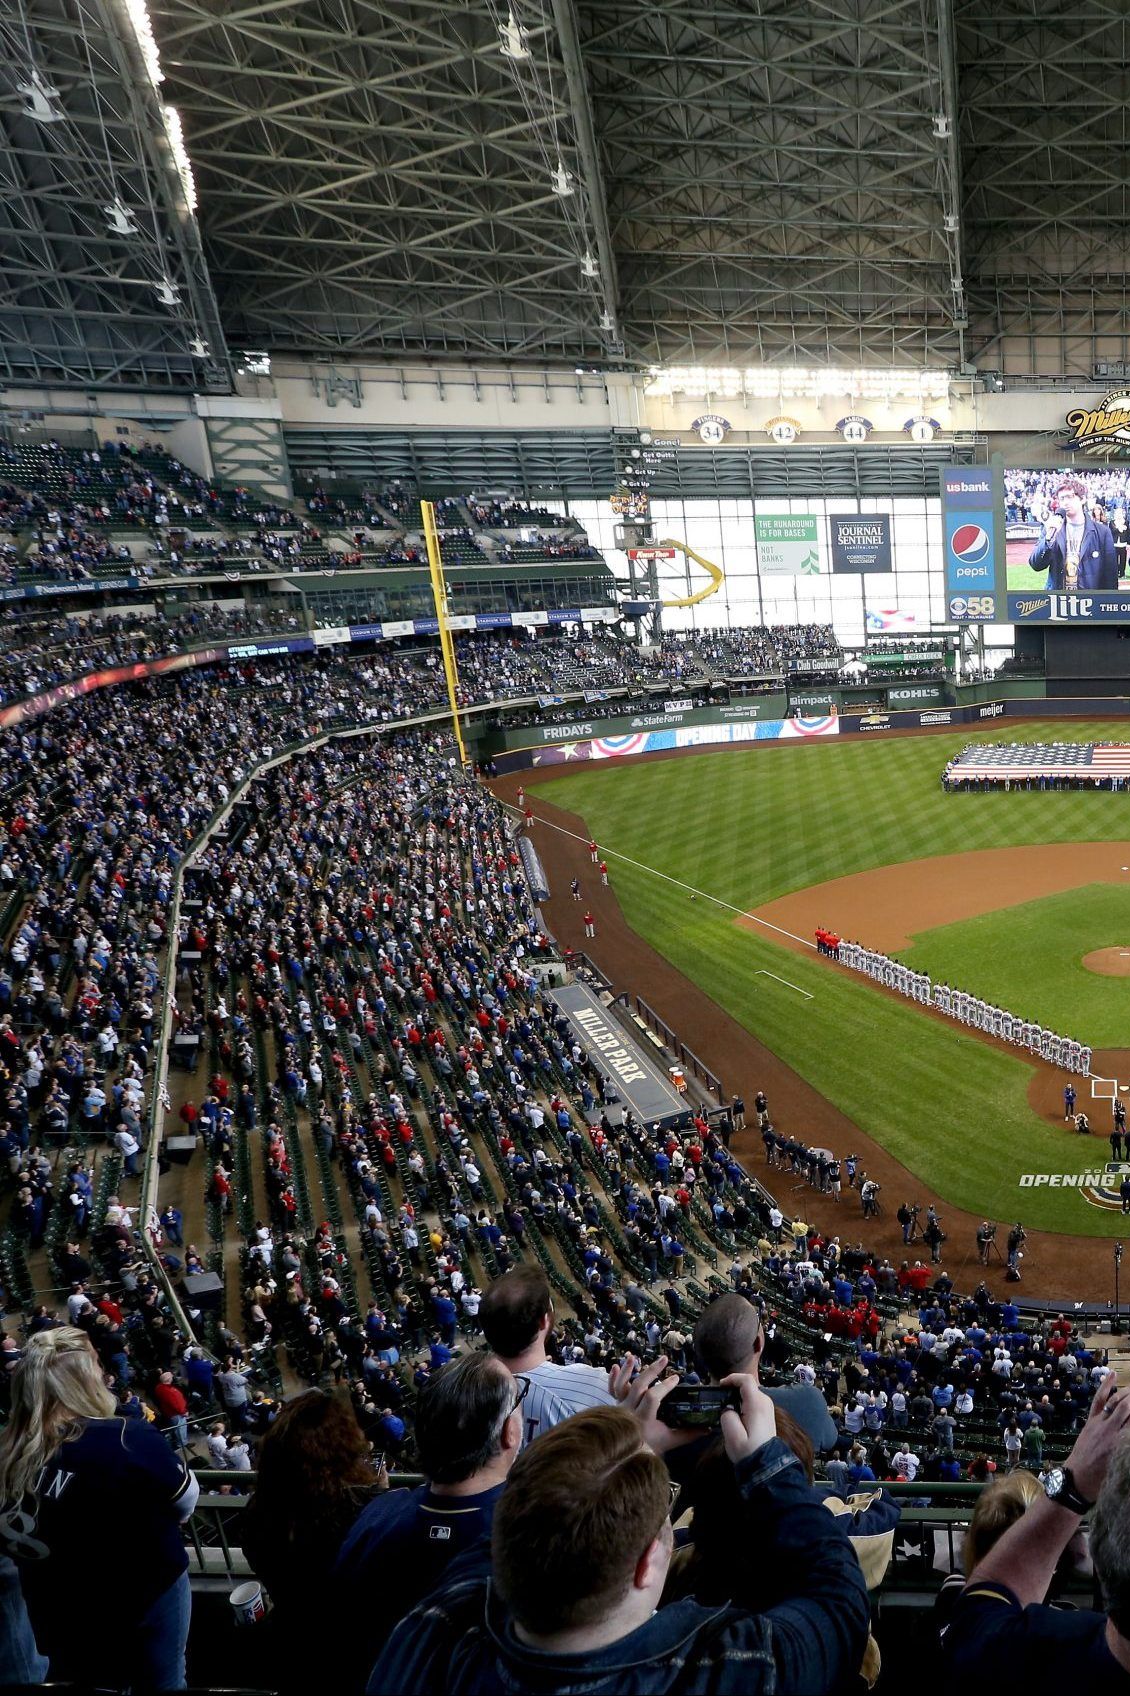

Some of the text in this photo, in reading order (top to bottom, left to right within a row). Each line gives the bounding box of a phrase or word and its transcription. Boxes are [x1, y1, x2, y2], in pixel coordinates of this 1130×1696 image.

[1107, 390, 1127, 402] SINCE
[702, 427, 721, 439] 34
[775, 427, 793, 439] 42
[846, 427, 864, 439] 44
[1078, 438, 1095, 448] HOME
[758, 519, 815, 529] THE RUNAROUND
[759, 529, 806, 538] IS FOR BASES
[838, 526, 884, 537] JOURNAL
[837, 536, 884, 546] SENTINEL
[761, 546, 774, 554] NOT
[761, 554, 784, 562] BANKS
[956, 565, 988, 579] pepsi
[966, 597, 995, 616] 58
[1016, 598, 1049, 617] Miller
[1048, 594, 1093, 621] Lite
[1100, 604, 1118, 612] THE
[796, 658, 840, 671] Club Goodwill
[889, 688, 940, 700] KOHL'S
[798, 695, 834, 706] impact
[980, 702, 1004, 719] meijer
[543, 724, 593, 739] FRIDAYS
[676, 721, 757, 746] OPENING DAY
[572, 1007, 620, 1052] MILLER
[604, 1049, 648, 1084] PARK
[1018, 1174, 1116, 1187] OPENING
